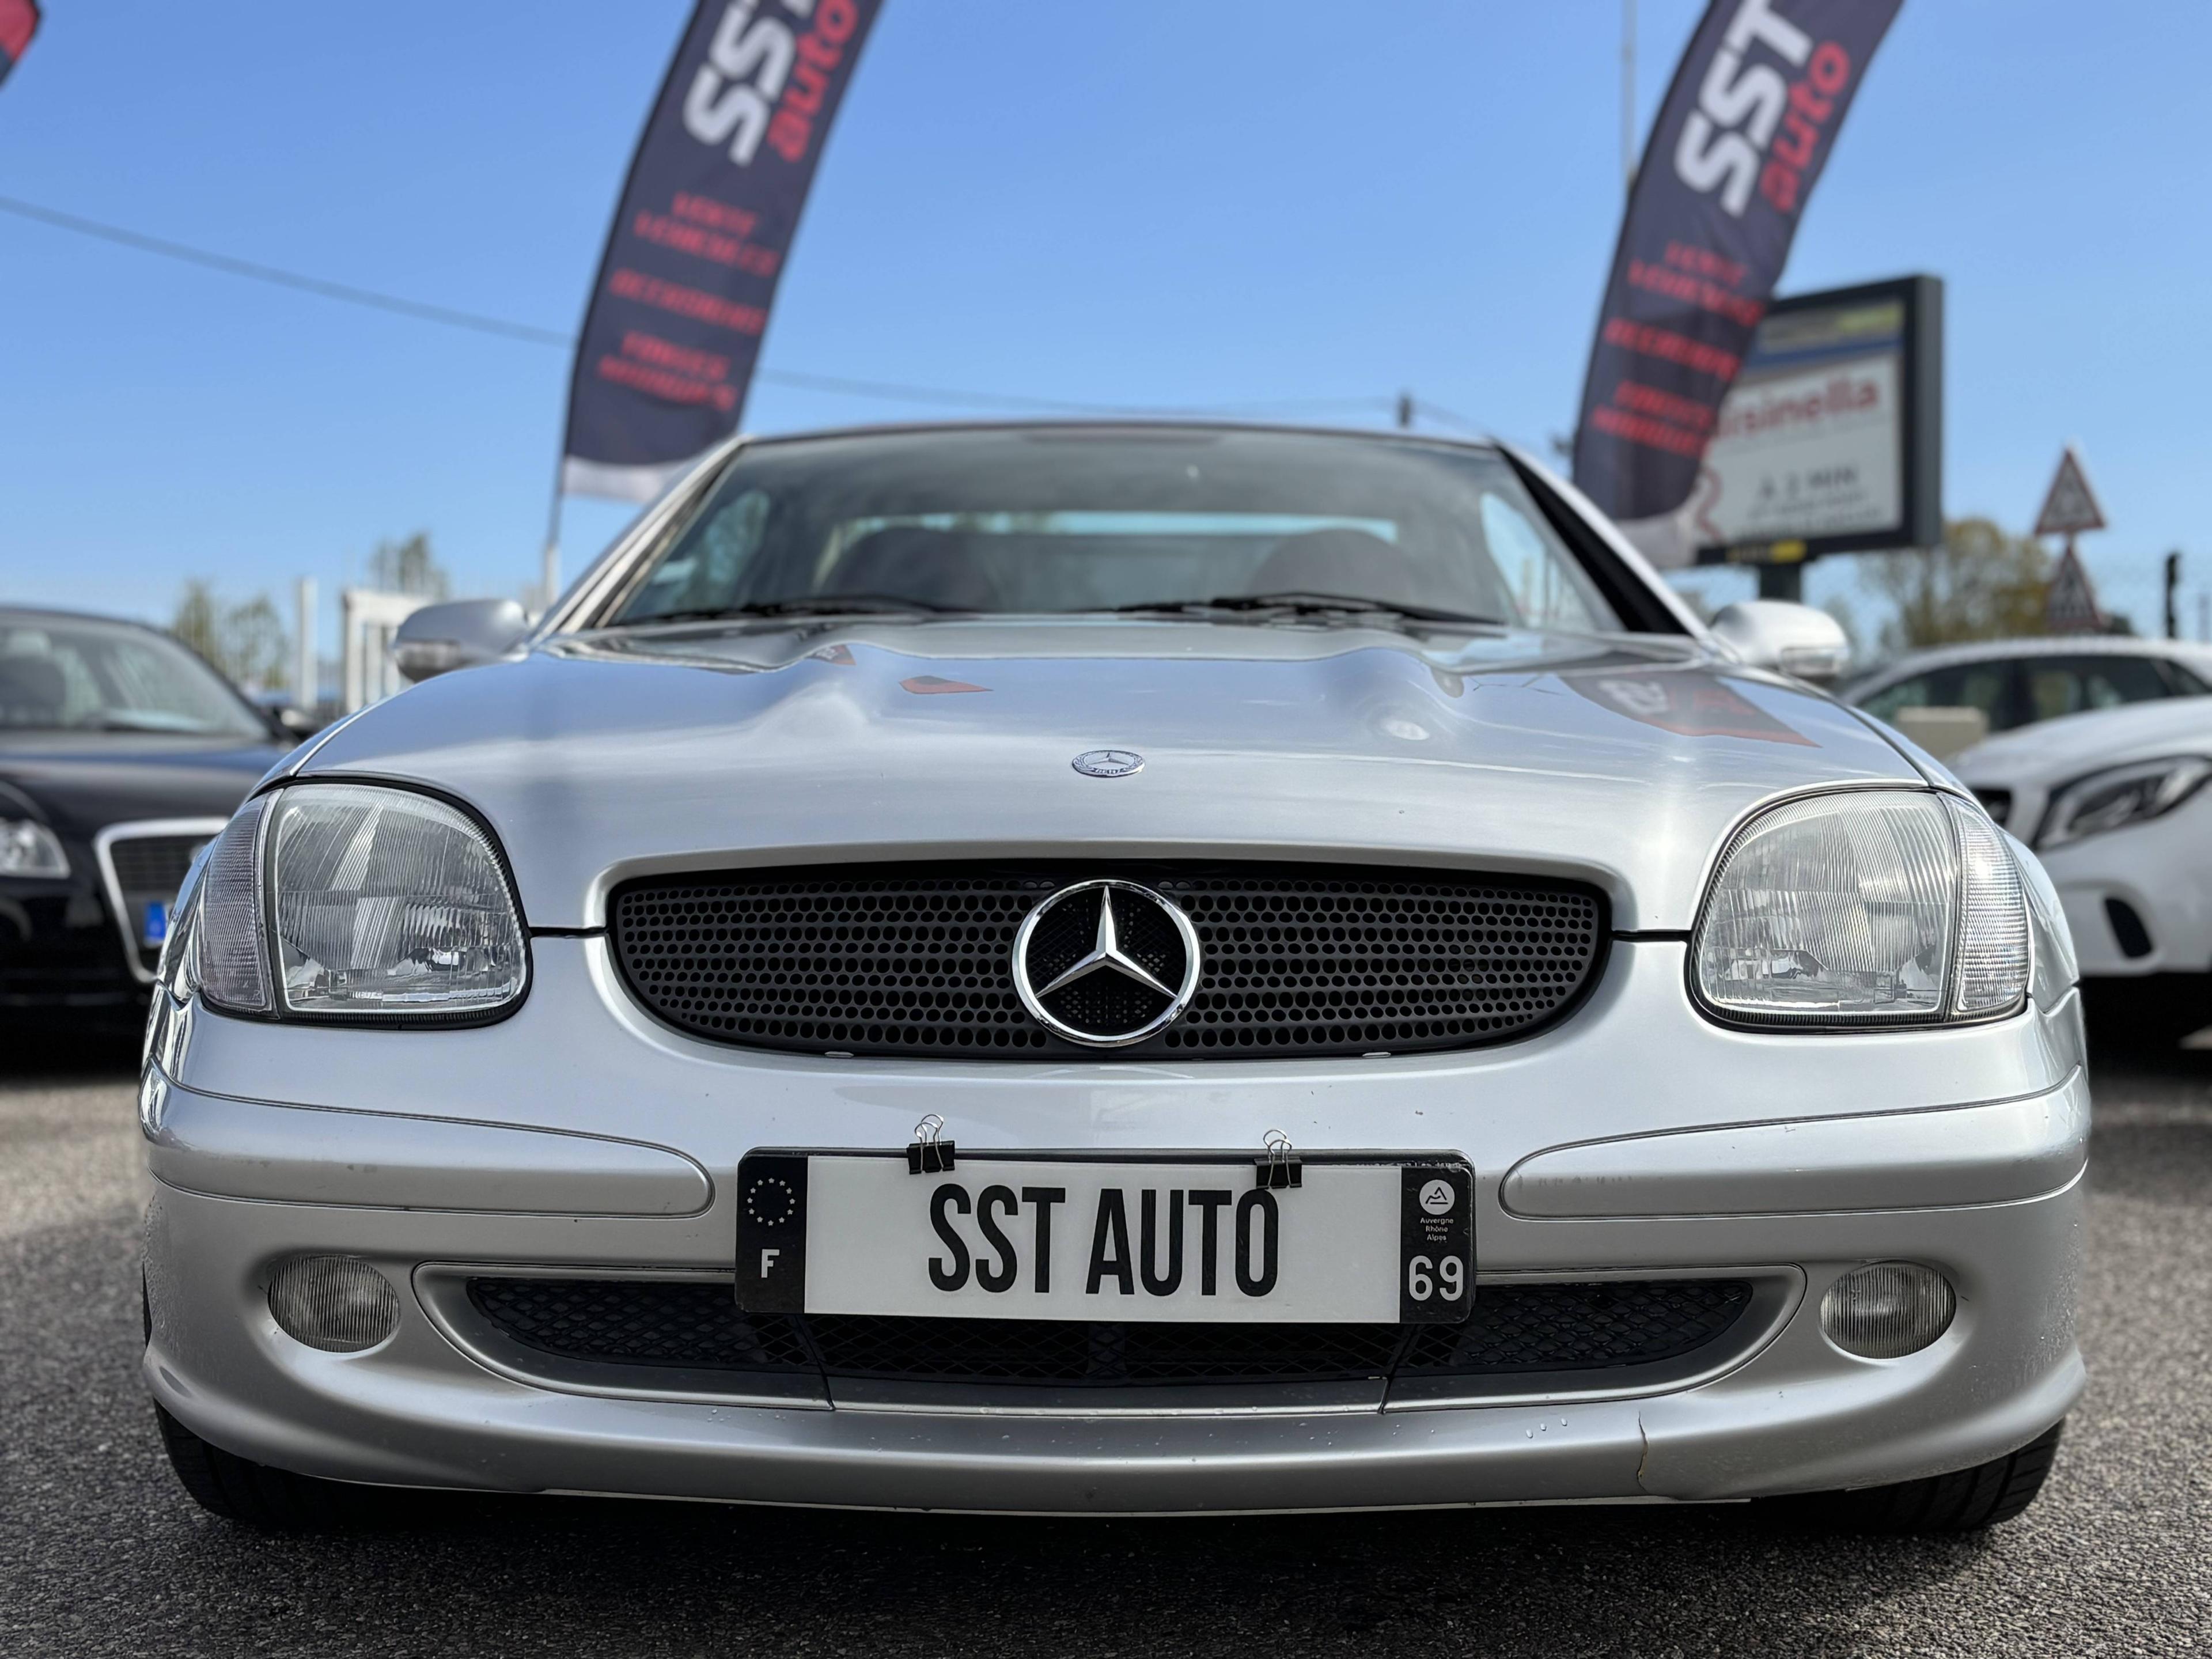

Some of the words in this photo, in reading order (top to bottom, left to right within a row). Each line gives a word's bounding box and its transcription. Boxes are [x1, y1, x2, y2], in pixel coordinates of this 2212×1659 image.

[683, 0, 814, 168] SS
[767, 0, 859, 162] auto
[1674, 0, 1812, 218] SST
[1760, 40, 1852, 213] auto
[760, 1248, 780, 1278] F
[929, 1183, 1066, 1294] SST
[1085, 1188, 1279, 1297] AUTO
[1409, 1255, 1464, 1301] 69
[1426, 1225, 1448, 1233] Rhône
[1427, 1233, 1447, 1241] Alpes
